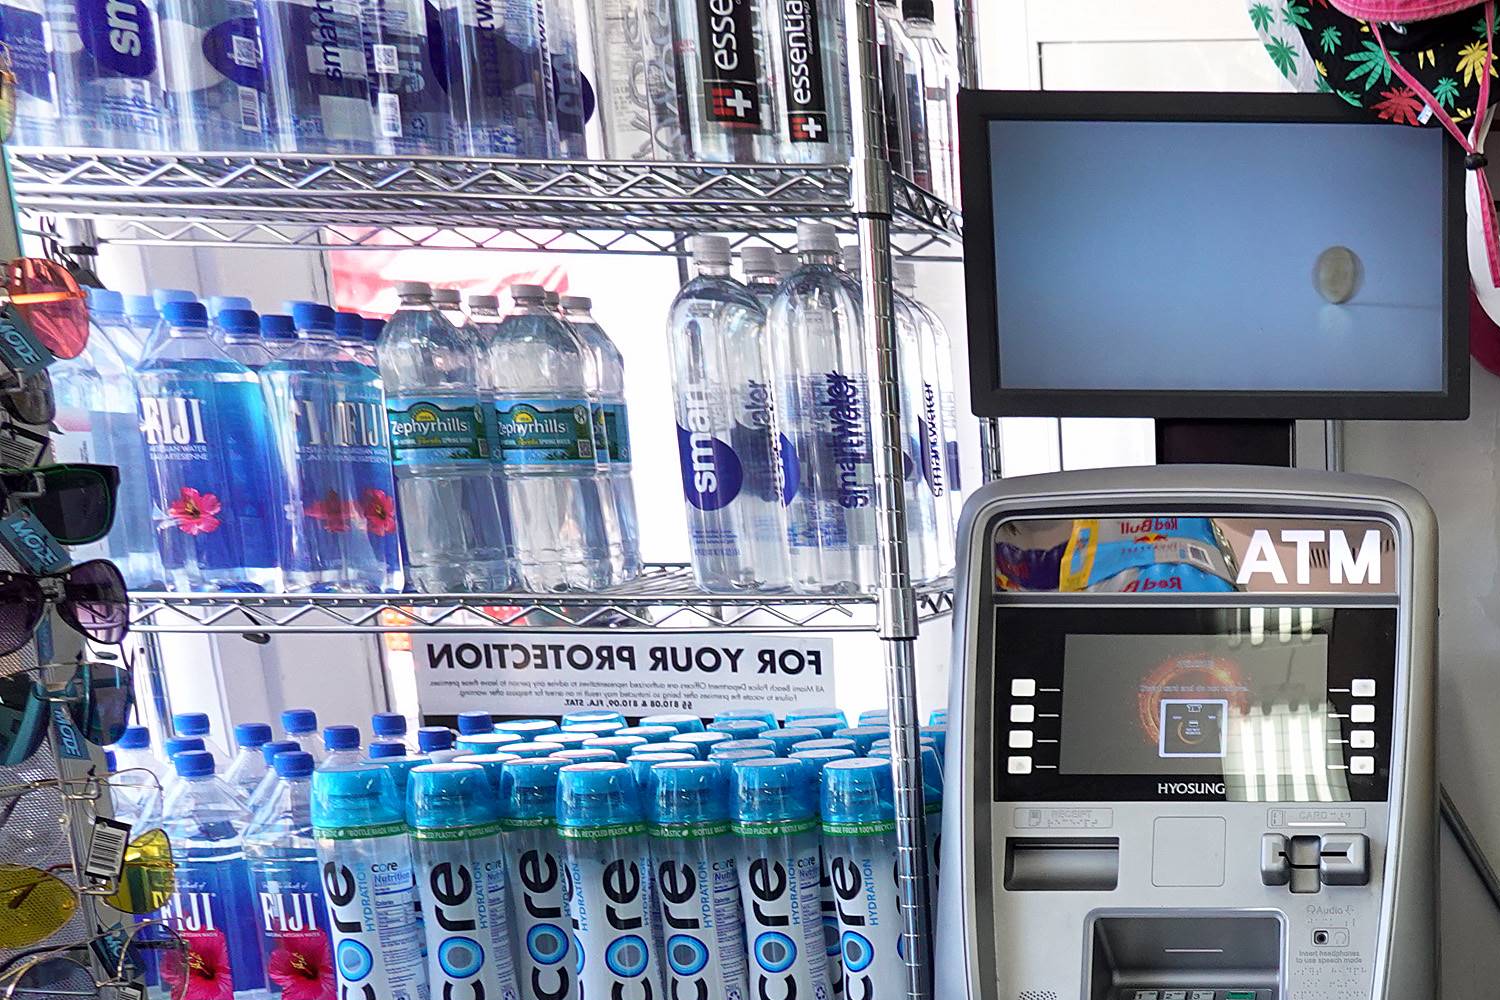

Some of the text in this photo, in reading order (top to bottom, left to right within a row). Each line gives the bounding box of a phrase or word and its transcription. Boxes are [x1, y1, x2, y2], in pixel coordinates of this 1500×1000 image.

[391, 419, 469, 436] Zephyrhills
[10, 517, 58, 566] MODE
[1236, 529, 1381, 585] ATM
[54, 707, 80, 758] MODE
[1158, 782, 1226, 796] HYOSUNG
[371, 861, 399, 873] core
[259, 892, 318, 932] FIJI
[863, 859, 879, 926] HYDRATION
